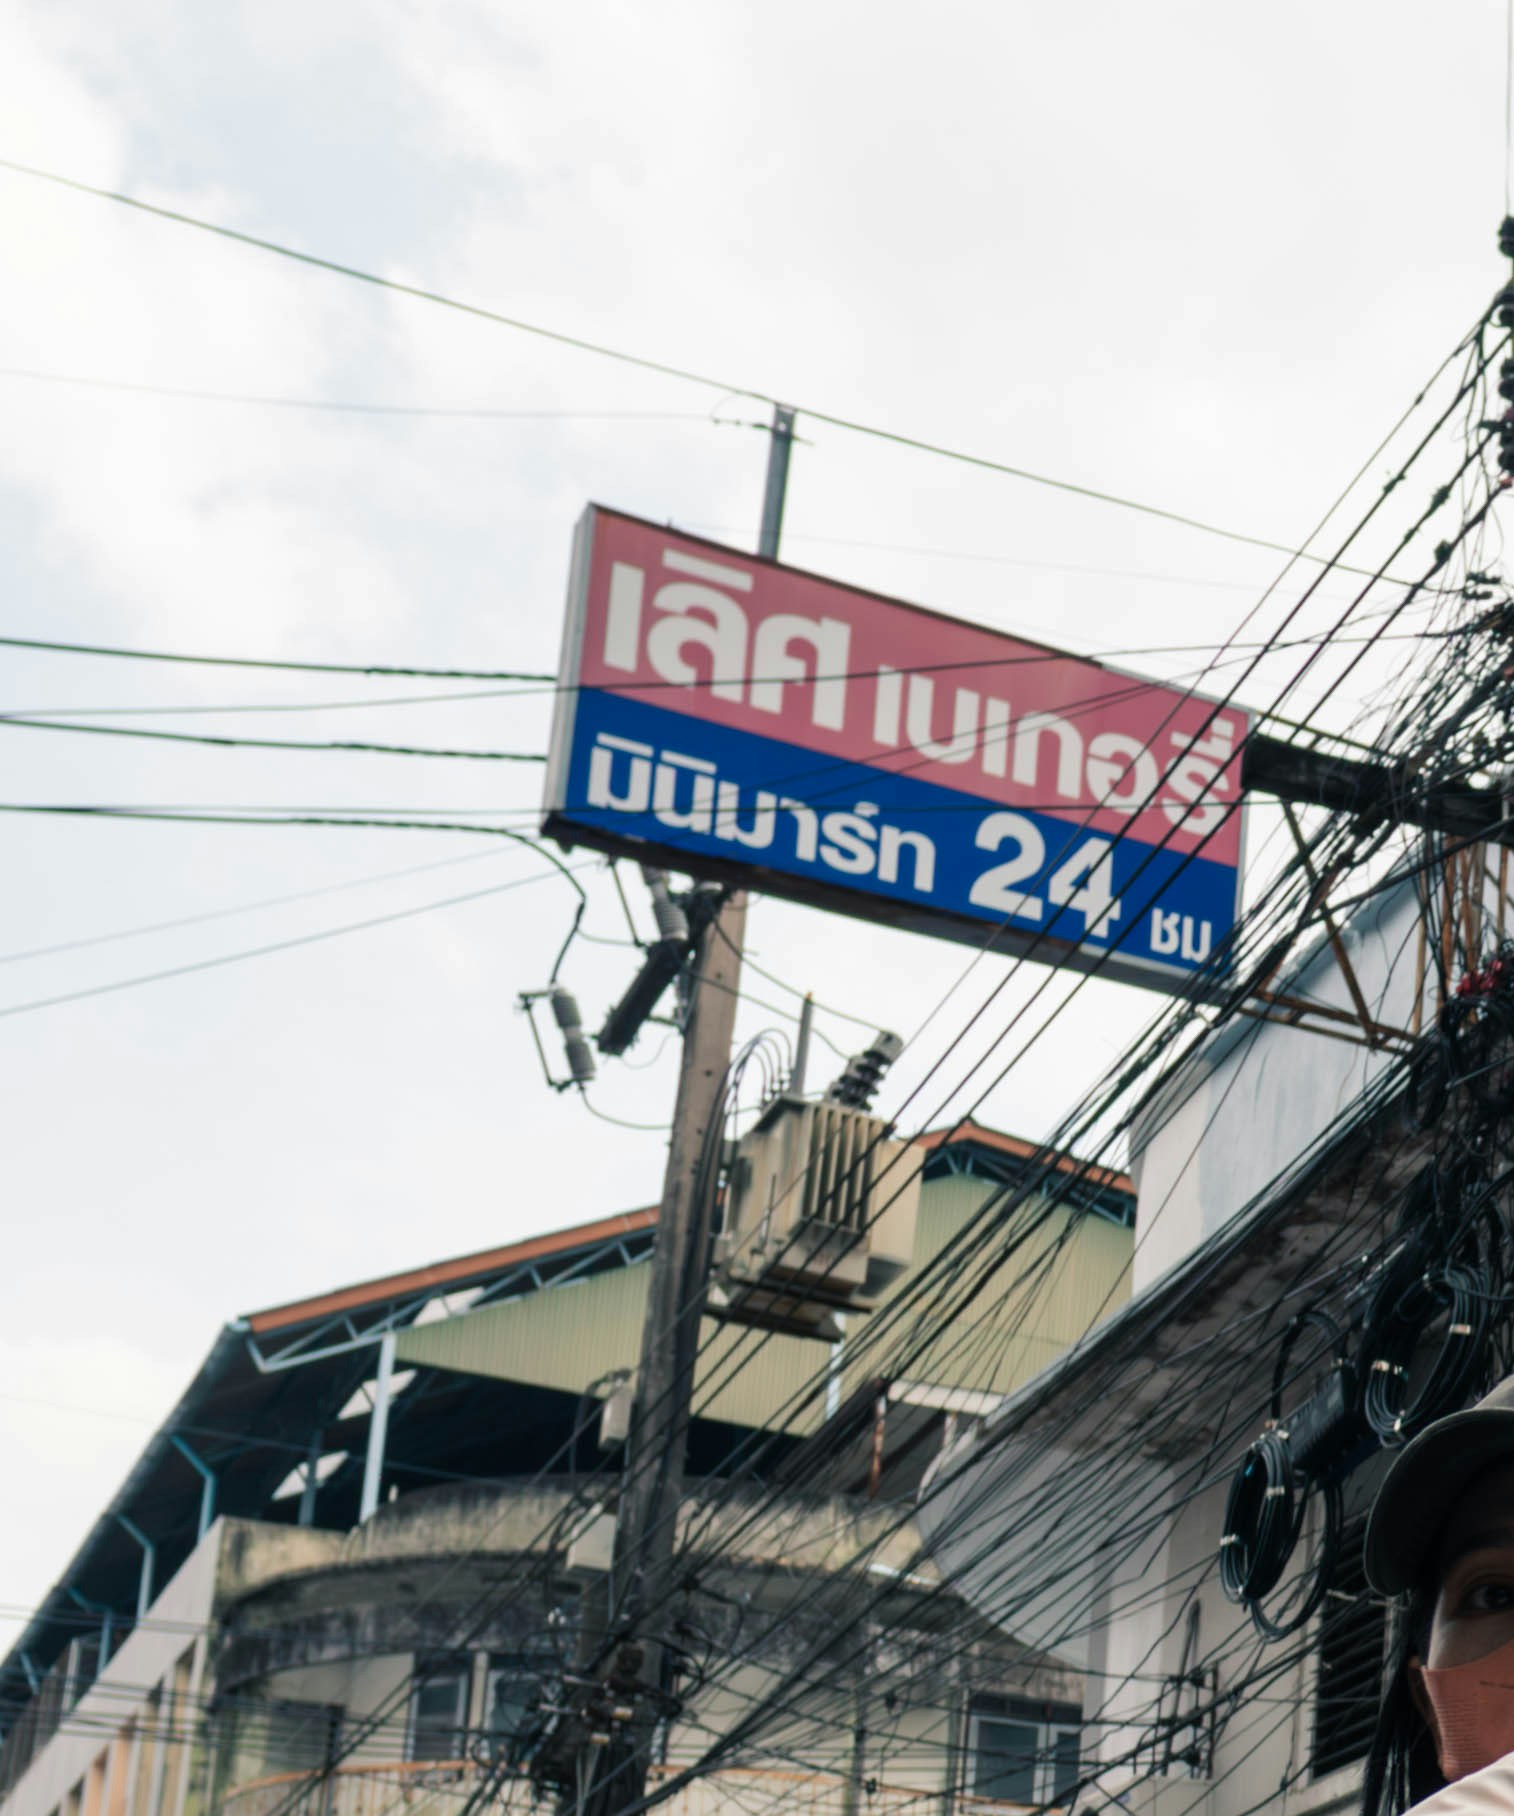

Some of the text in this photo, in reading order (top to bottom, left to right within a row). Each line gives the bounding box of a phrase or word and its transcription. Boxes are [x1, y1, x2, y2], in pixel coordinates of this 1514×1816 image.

[602, 548, 1235, 836] เลิศ เบเกอรี่
[587, 732, 936, 894] มินิมาร์ท
[968, 813, 1122, 938] 24
